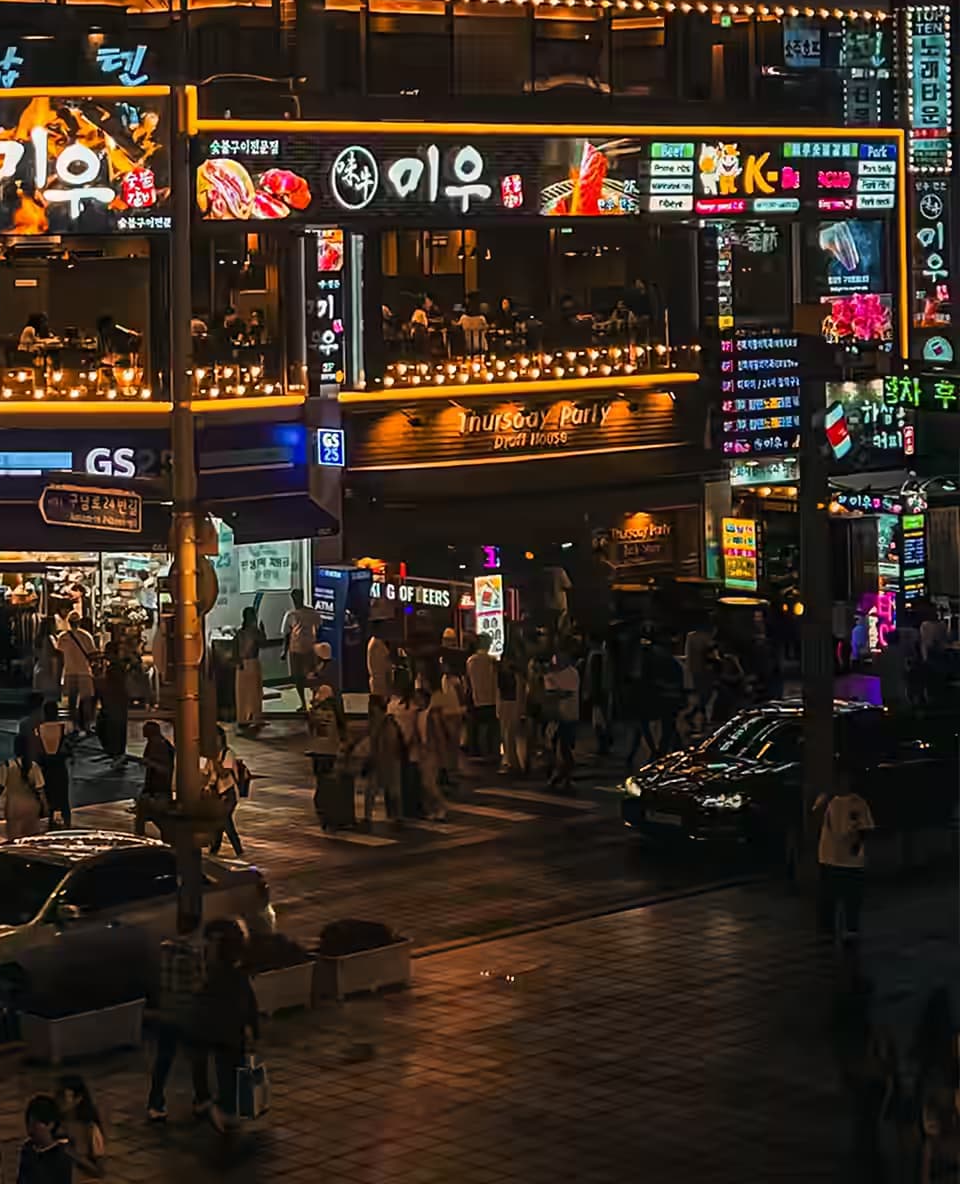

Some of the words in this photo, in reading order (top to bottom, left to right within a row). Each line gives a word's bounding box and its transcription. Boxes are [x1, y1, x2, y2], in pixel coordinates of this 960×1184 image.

[916, 23, 942, 34] TEN
[96, 45, 149, 87] 텐
[921, 39, 940, 124] 노래타운
[388, 144, 491, 214] 미우
[457, 408, 547, 437] Thursday
[560, 403, 611, 428] Party
[323, 432, 340, 447] GS
[323, 446, 341, 463] 25
[399, 583, 414, 602] OF
